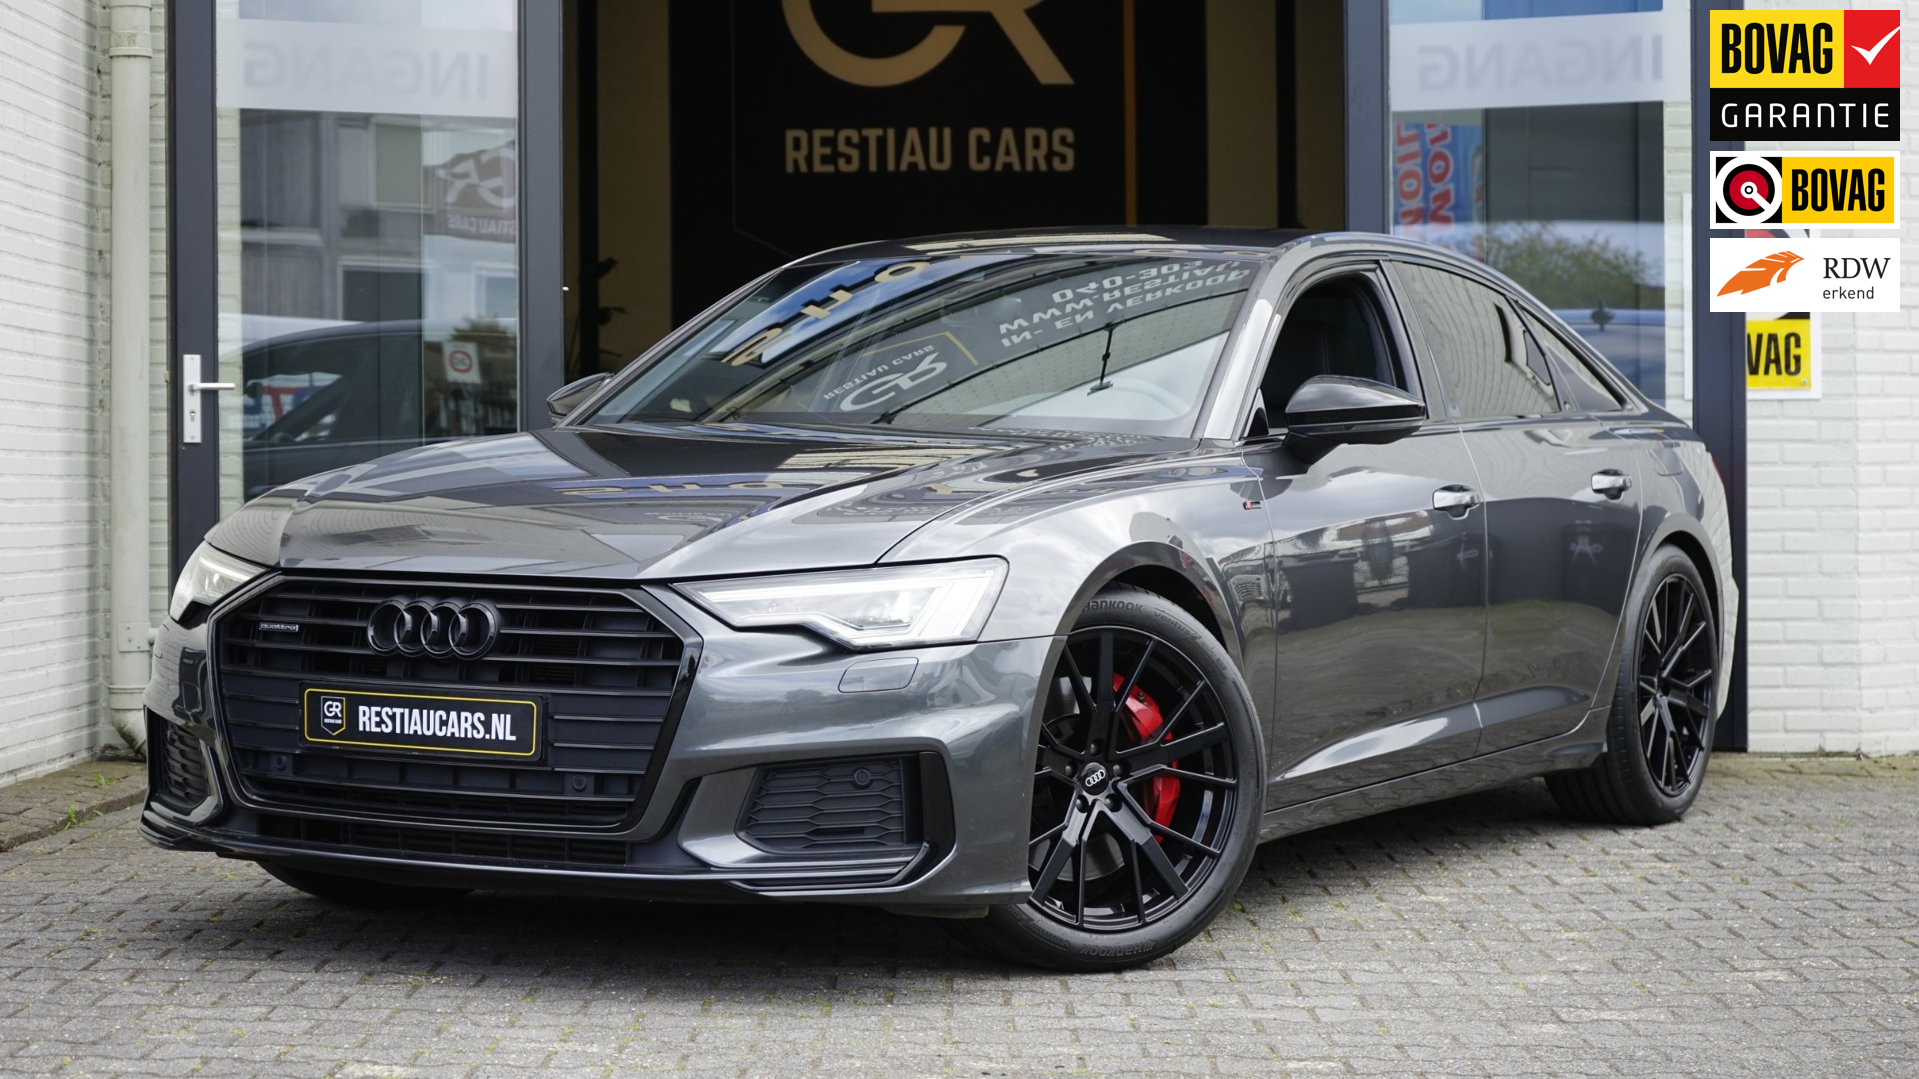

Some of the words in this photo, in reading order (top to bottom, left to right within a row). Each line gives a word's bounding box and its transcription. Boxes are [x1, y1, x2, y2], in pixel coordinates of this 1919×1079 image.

[785, 127, 951, 172] RESTIAU
[968, 127, 1075, 172] CARS
[1746, 332, 1801, 376] VAG
[358, 705, 516, 741] RESTIAUCARS.NL
